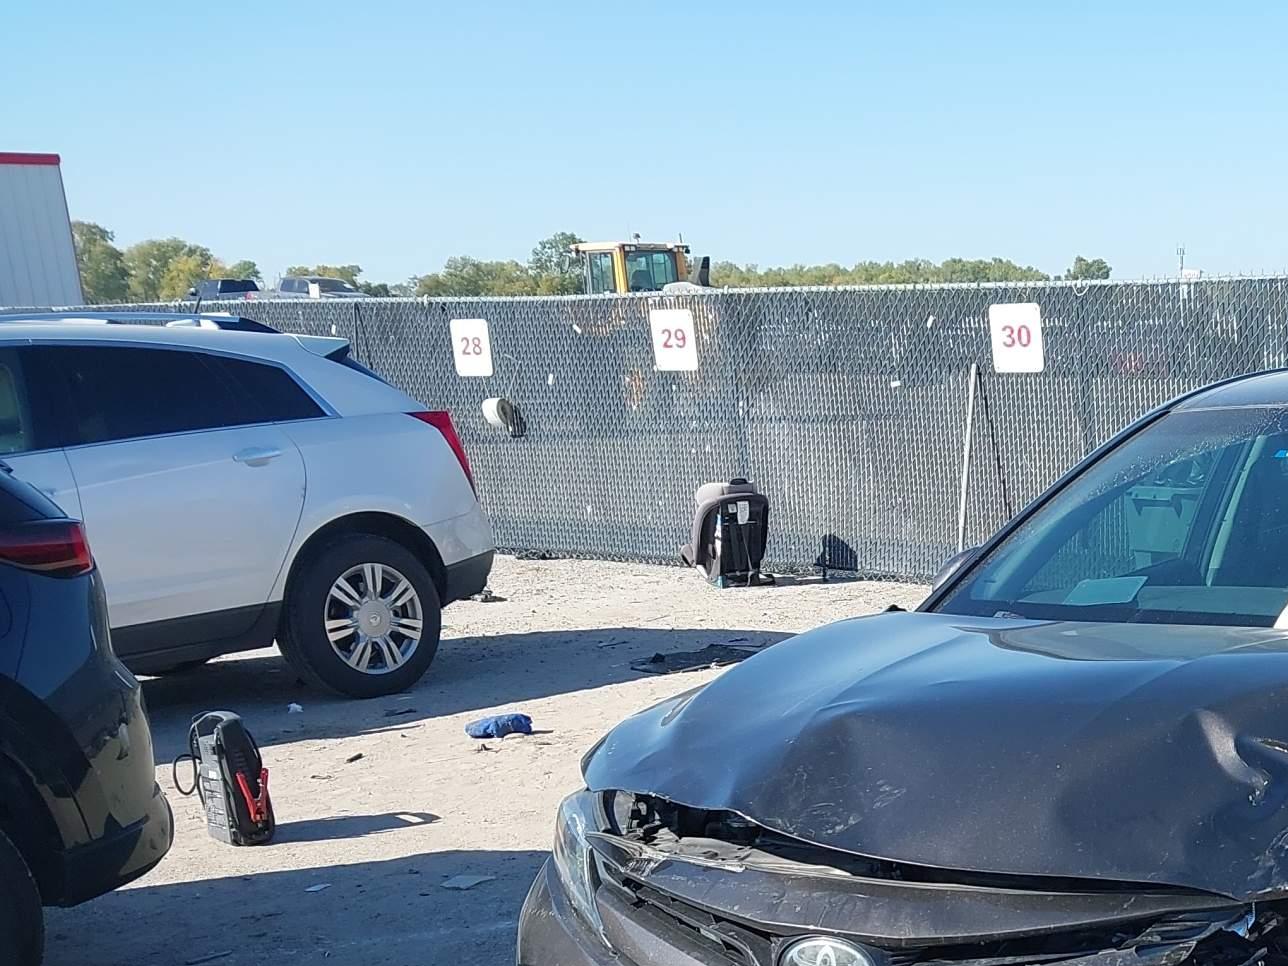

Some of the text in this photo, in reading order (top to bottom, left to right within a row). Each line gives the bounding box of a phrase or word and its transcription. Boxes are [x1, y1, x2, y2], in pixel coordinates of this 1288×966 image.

[460, 336, 483, 355] 28
[661, 328, 687, 348] 29
[1001, 325, 1032, 348] 30
